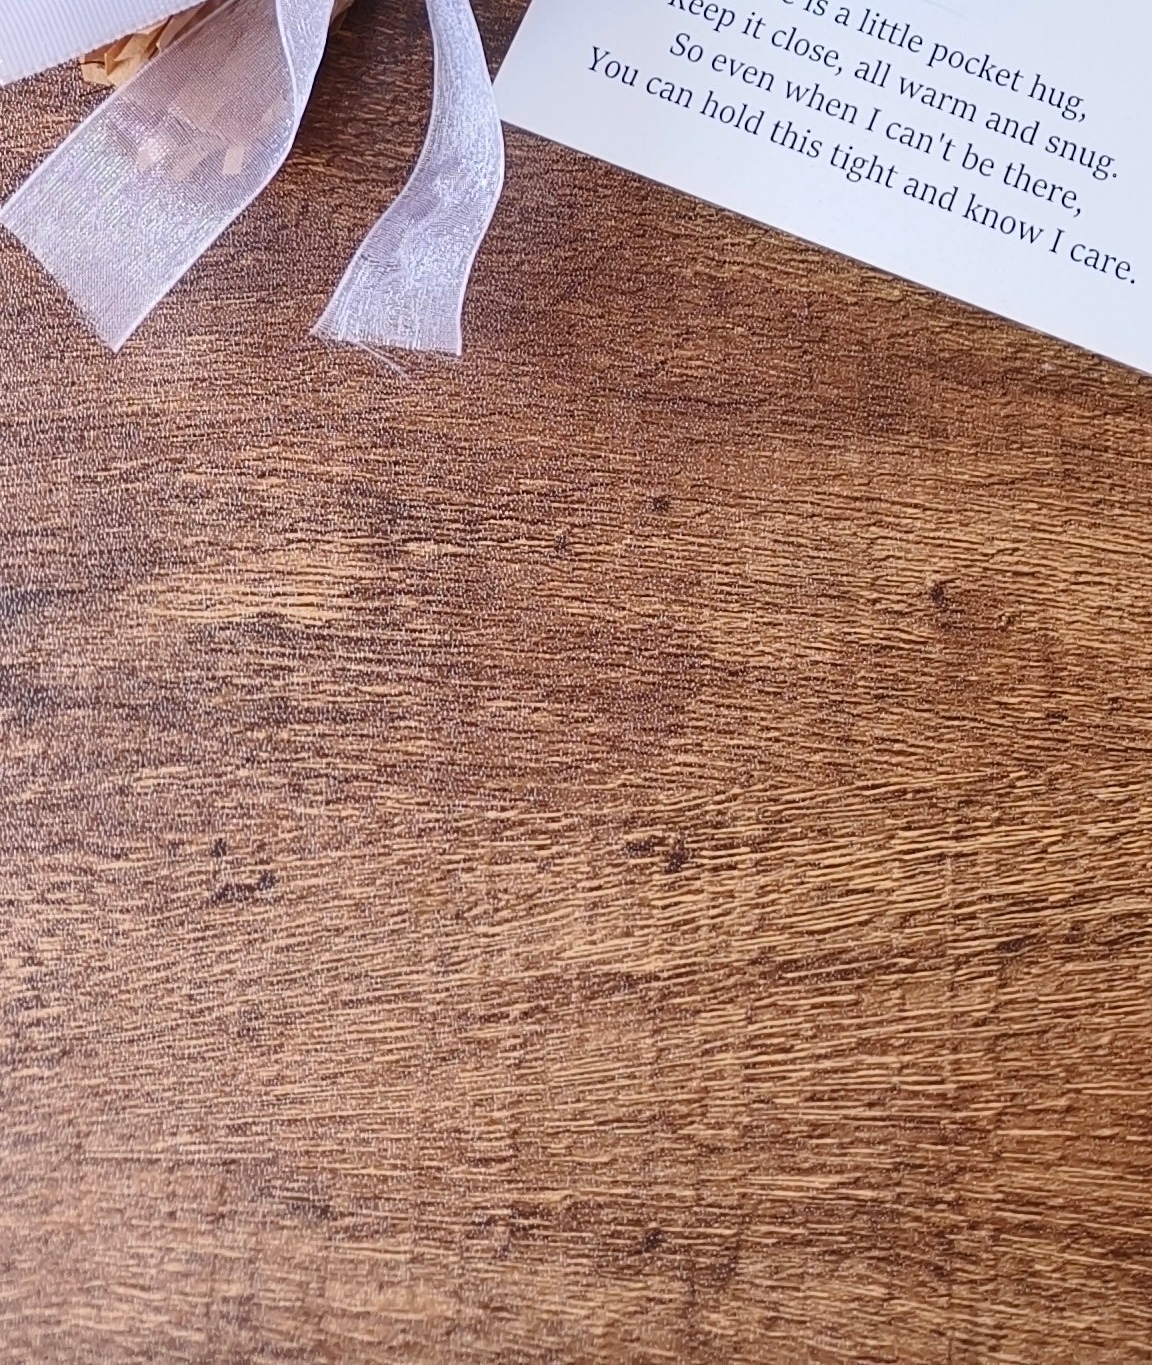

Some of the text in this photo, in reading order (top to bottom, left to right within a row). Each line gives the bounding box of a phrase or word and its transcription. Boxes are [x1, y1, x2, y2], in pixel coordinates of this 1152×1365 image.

[669, 32, 1081, 218] So even when I can't be there,
[741, 11, 766, 40] it
[771, 26, 843, 76] close,
[854, 60, 891, 88] all
[898, 75, 977, 123] warm
[985, 112, 1041, 146] and
[1044, 135, 1117, 181] snug.
[834, 7, 851, 27] a
[857, 8, 923, 53] little
[926, 43, 1024, 92] pocket
[1026, 73, 1086, 123] hug,
[588, 45, 1136, 284] You can hold this tight and know I care.
